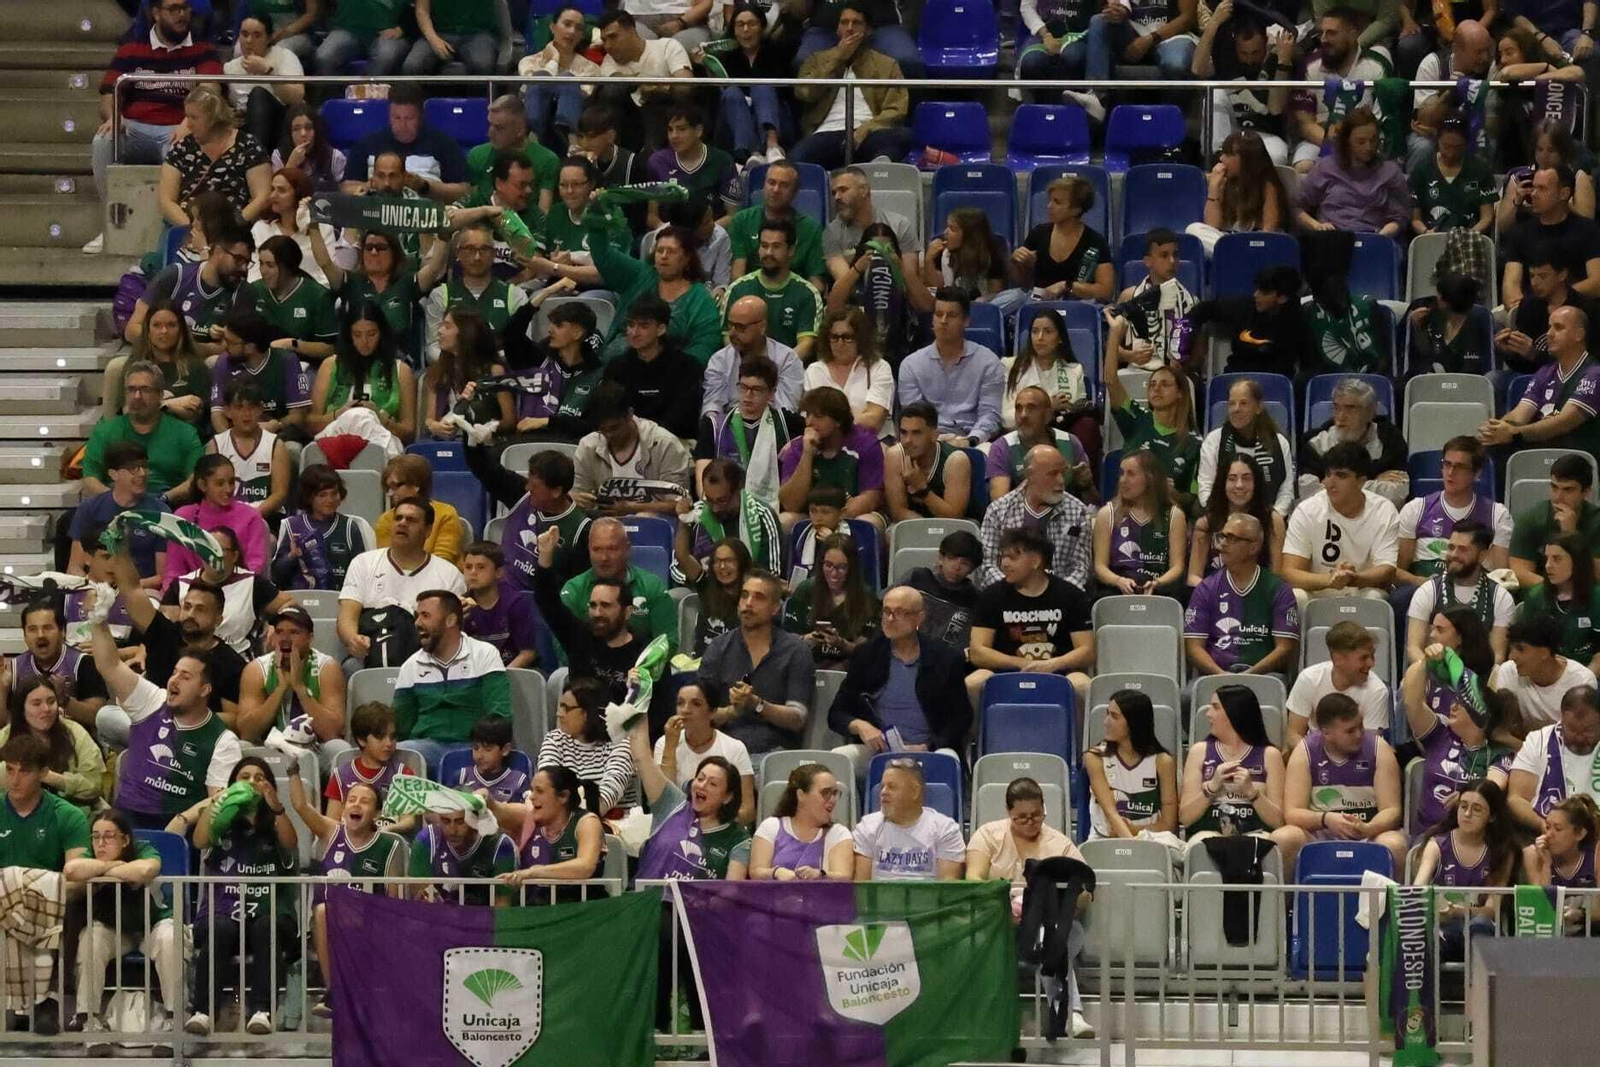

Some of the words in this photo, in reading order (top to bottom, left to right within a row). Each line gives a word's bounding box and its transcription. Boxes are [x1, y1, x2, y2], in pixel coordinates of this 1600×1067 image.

[381, 204, 437, 228] UNICAJA
[1003, 608, 1062, 624] MOSCHINO
[880, 850, 904, 865] LAZY
[905, 851, 929, 864] DAYS
[237, 863, 276, 875] Unicaja
[1393, 884, 1429, 990] BALONCESTO
[837, 962, 906, 982] Fundación
[850, 978, 899, 995] Unicaja
[842, 987, 910, 1009] Baloncesto
[463, 1013, 521, 1030] Unicaja
[462, 1032, 522, 1041] Baloncesto
